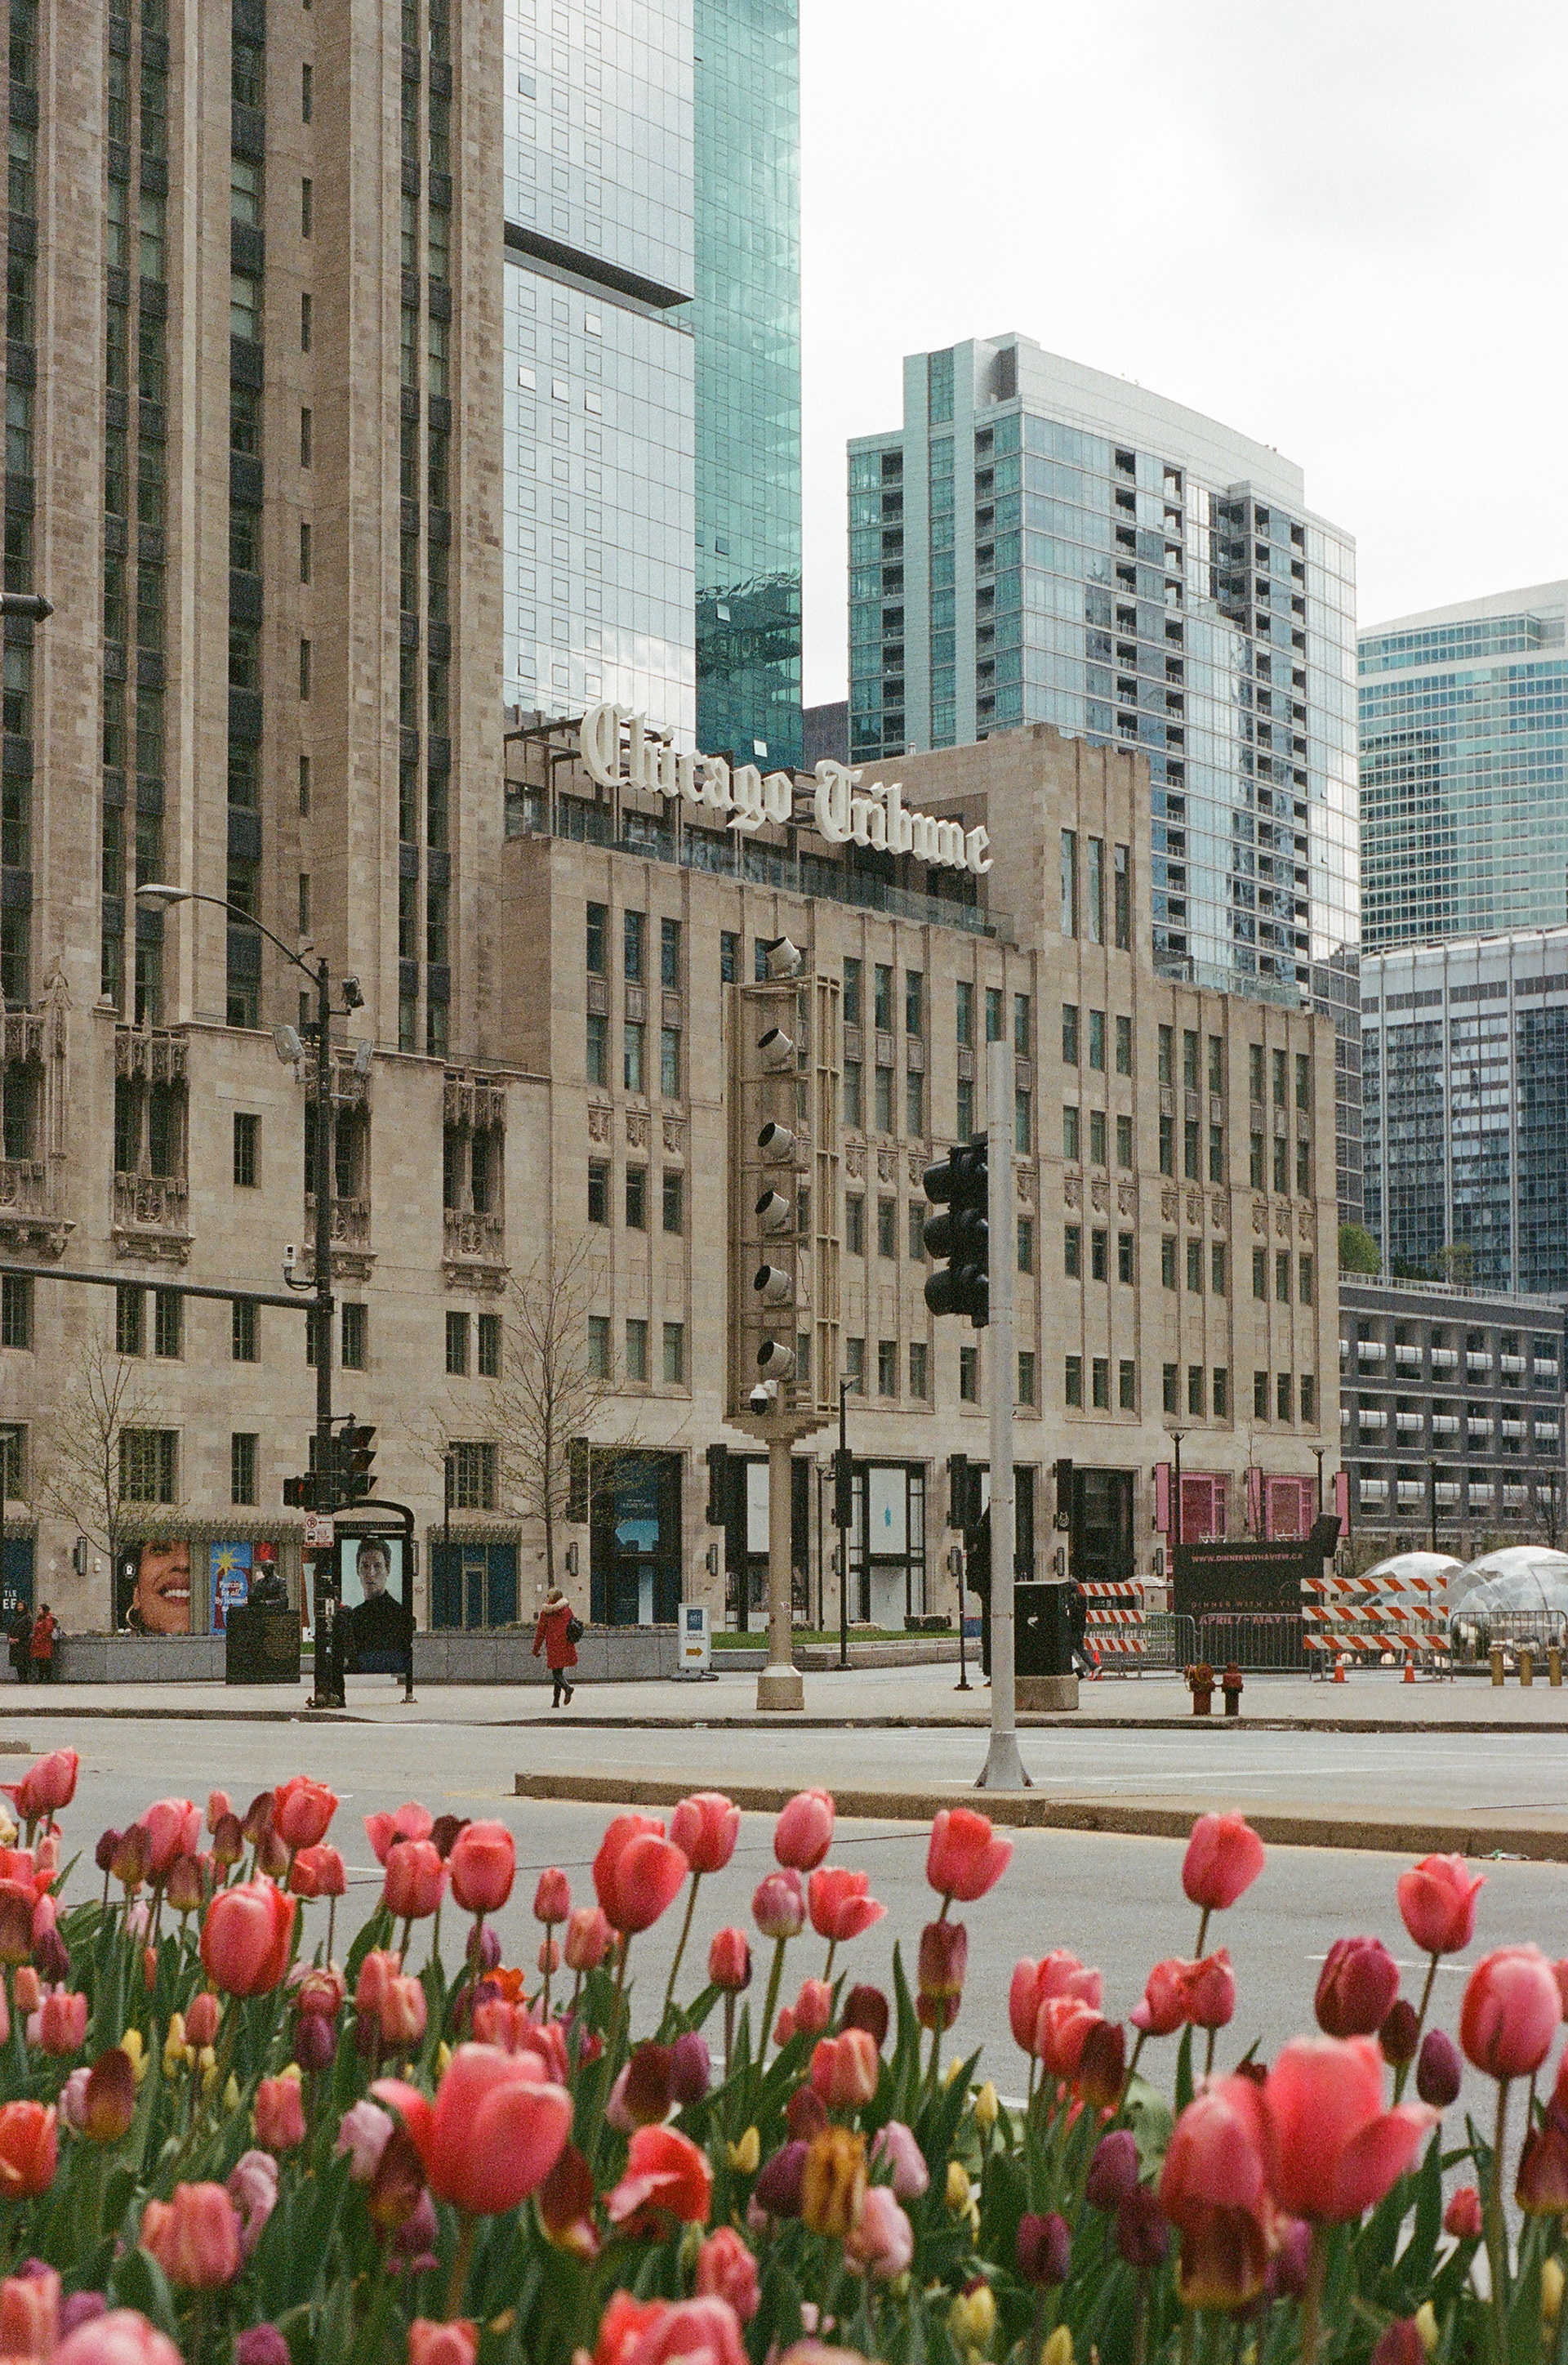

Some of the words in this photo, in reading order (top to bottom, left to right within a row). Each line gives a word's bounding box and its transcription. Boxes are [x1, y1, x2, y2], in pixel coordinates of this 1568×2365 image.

[580, 703, 793, 831] Chicago
[815, 759, 993, 873] Tribune
[1199, 1614, 1233, 1625] APRIL
[1253, 1614, 1281, 1624] MAY
